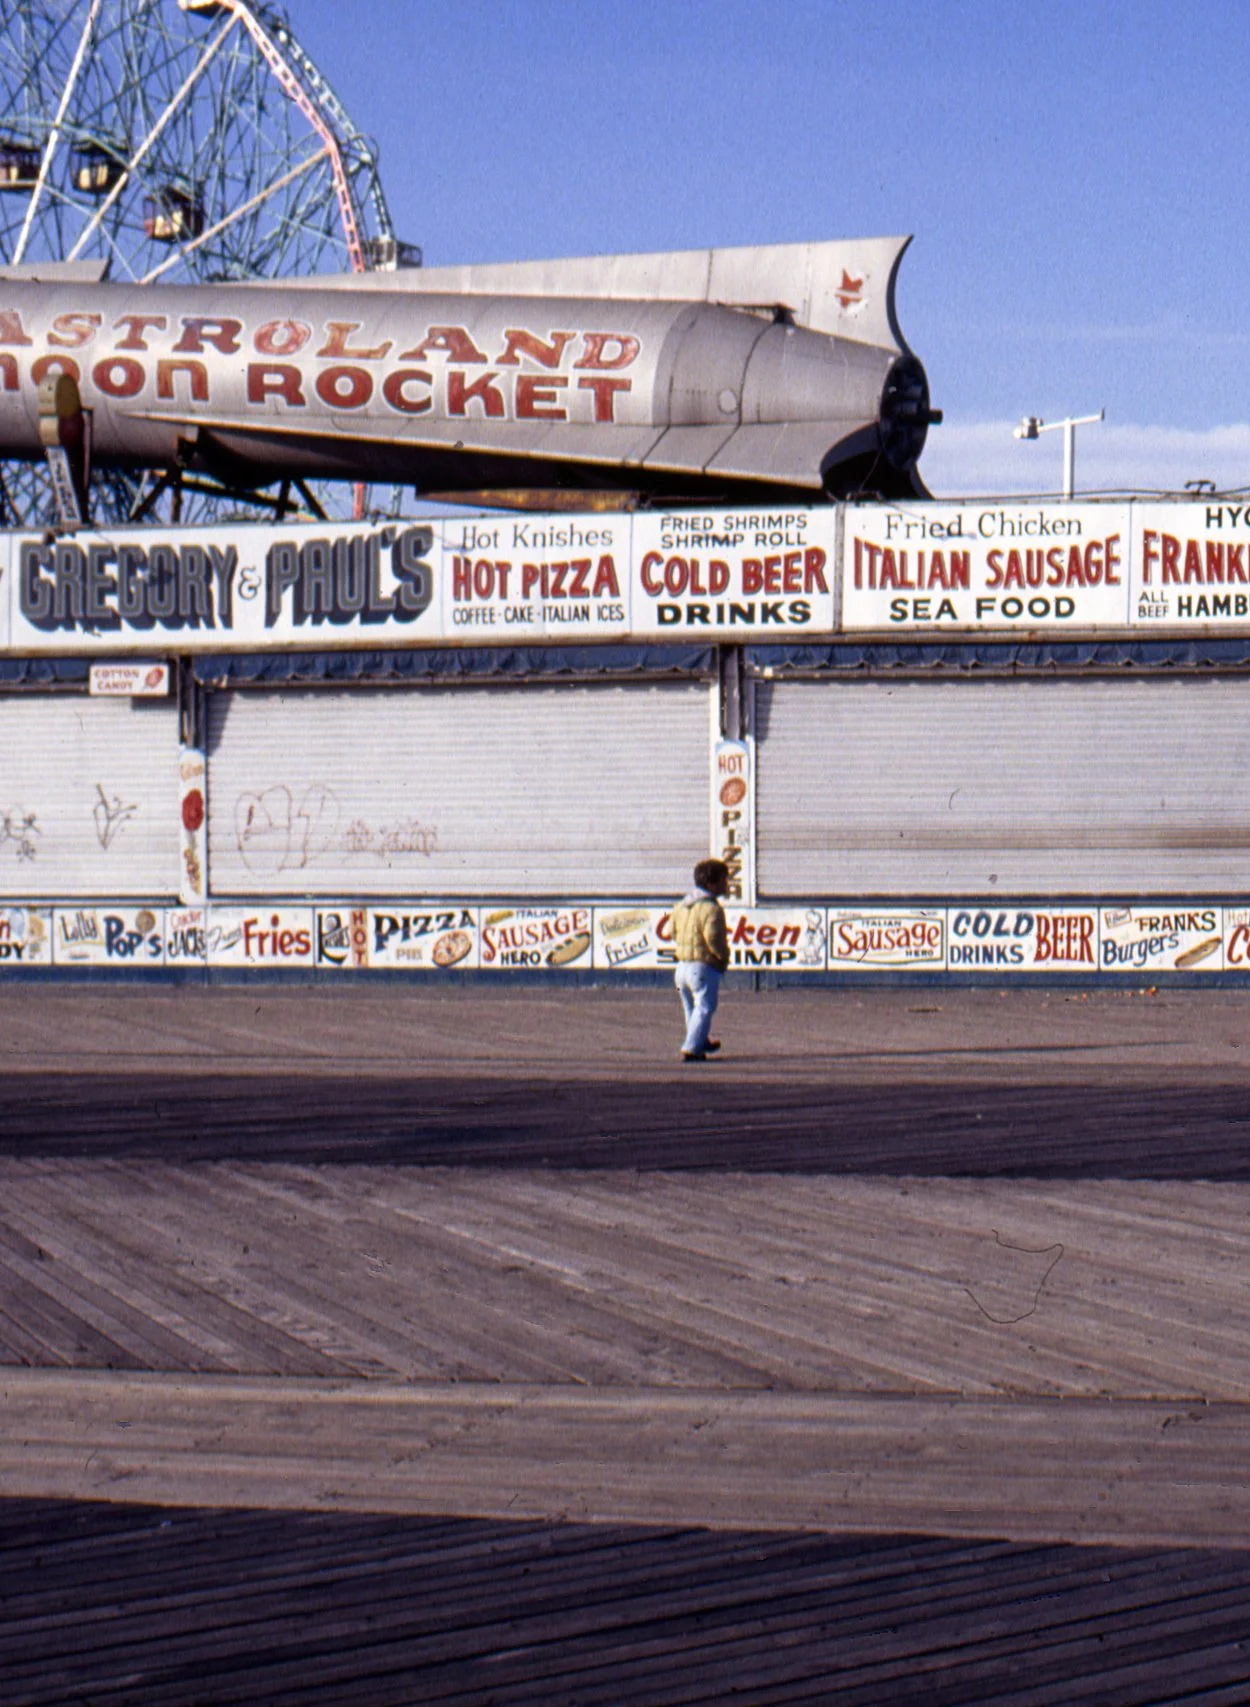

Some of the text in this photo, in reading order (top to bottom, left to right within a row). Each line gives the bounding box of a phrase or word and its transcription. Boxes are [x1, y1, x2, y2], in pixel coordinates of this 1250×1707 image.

[247, 362, 632, 423] ROCKET
[660, 514, 807, 531] FRIED SHRIMPS
[885, 511, 1082, 540] Fried Chicken
[462, 523, 613, 549] Hot Knishes
[661, 532, 807, 549] SHRIMP ROLL
[640, 547, 829, 597] COLD BEER
[854, 533, 1121, 590] ITALIAN SAUSAGE
[20, 525, 434, 632] GREGORY & PAUL'S
[453, 554, 621, 601] HOT PIZZA
[890, 597, 1075, 621] SEA FOOD
[1139, 591, 1168, 602] ALL
[453, 604, 624, 625] COFFEE CAKE ITALIAN ICES
[657, 601, 811, 625] DRINKS
[1138, 604, 1169, 618] BEEF
[95, 669, 140, 678] COTTON
[97, 680, 133, 689] CANDY
[718, 753, 744, 774] HOT
[722, 810, 743, 900] PIZZA
[516, 909, 558, 918] ITALIAN
[953, 911, 1033, 937] COLD
[1135, 911, 1216, 932] FRANKS
[244, 913, 311, 957] Fries
[352, 911, 366, 964] HOT
[374, 909, 476, 953] PIZZA
[482, 910, 588, 961] SAUSAGE
[656, 912, 801, 946] Cken
[838, 922, 940, 956] Sausage
[1034, 914, 1095, 963] BEER
[501, 951, 541, 966] HERO
[657, 948, 797, 965] SIMP
[906, 949, 934, 957] HERO
[950, 944, 1024, 964] DRINKS
[1102, 933, 1180, 967] Burgers
